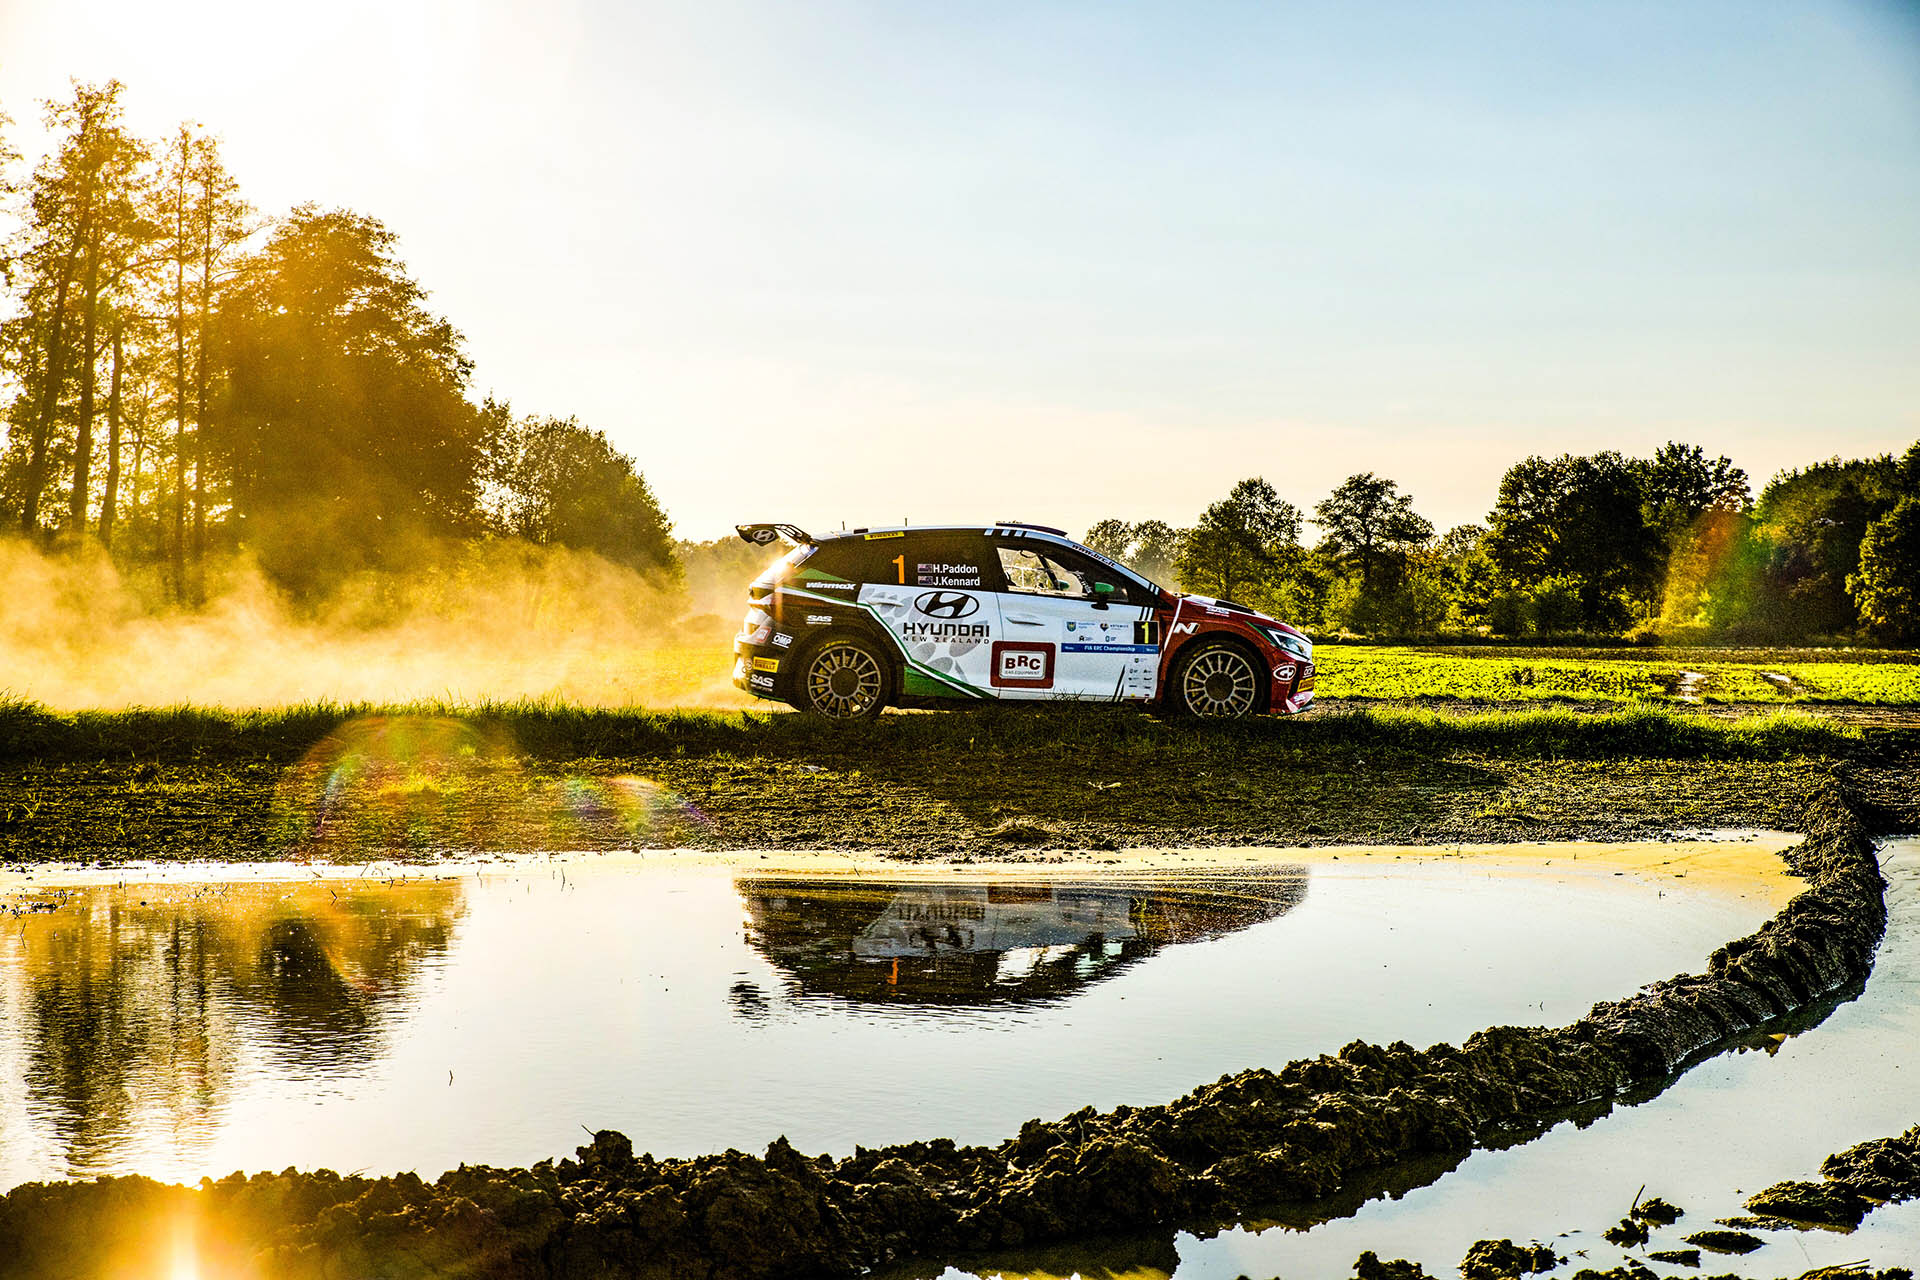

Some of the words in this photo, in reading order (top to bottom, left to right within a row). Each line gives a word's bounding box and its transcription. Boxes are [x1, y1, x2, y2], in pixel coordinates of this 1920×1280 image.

[892, 554, 905, 585] 1
[933, 563, 978, 574] H.Paddon
[806, 582, 857, 590] winmax
[933, 576, 981, 586] J.Kennard
[806, 614, 833, 622] SAS
[903, 622, 990, 637] HYUNDAI
[1141, 621, 1150, 644] 1
[773, 634, 792, 646] OMP
[934, 636, 990, 644] ZEALAND
[1004, 655, 1041, 670] BRC
[750, 674, 775, 687] SAS
